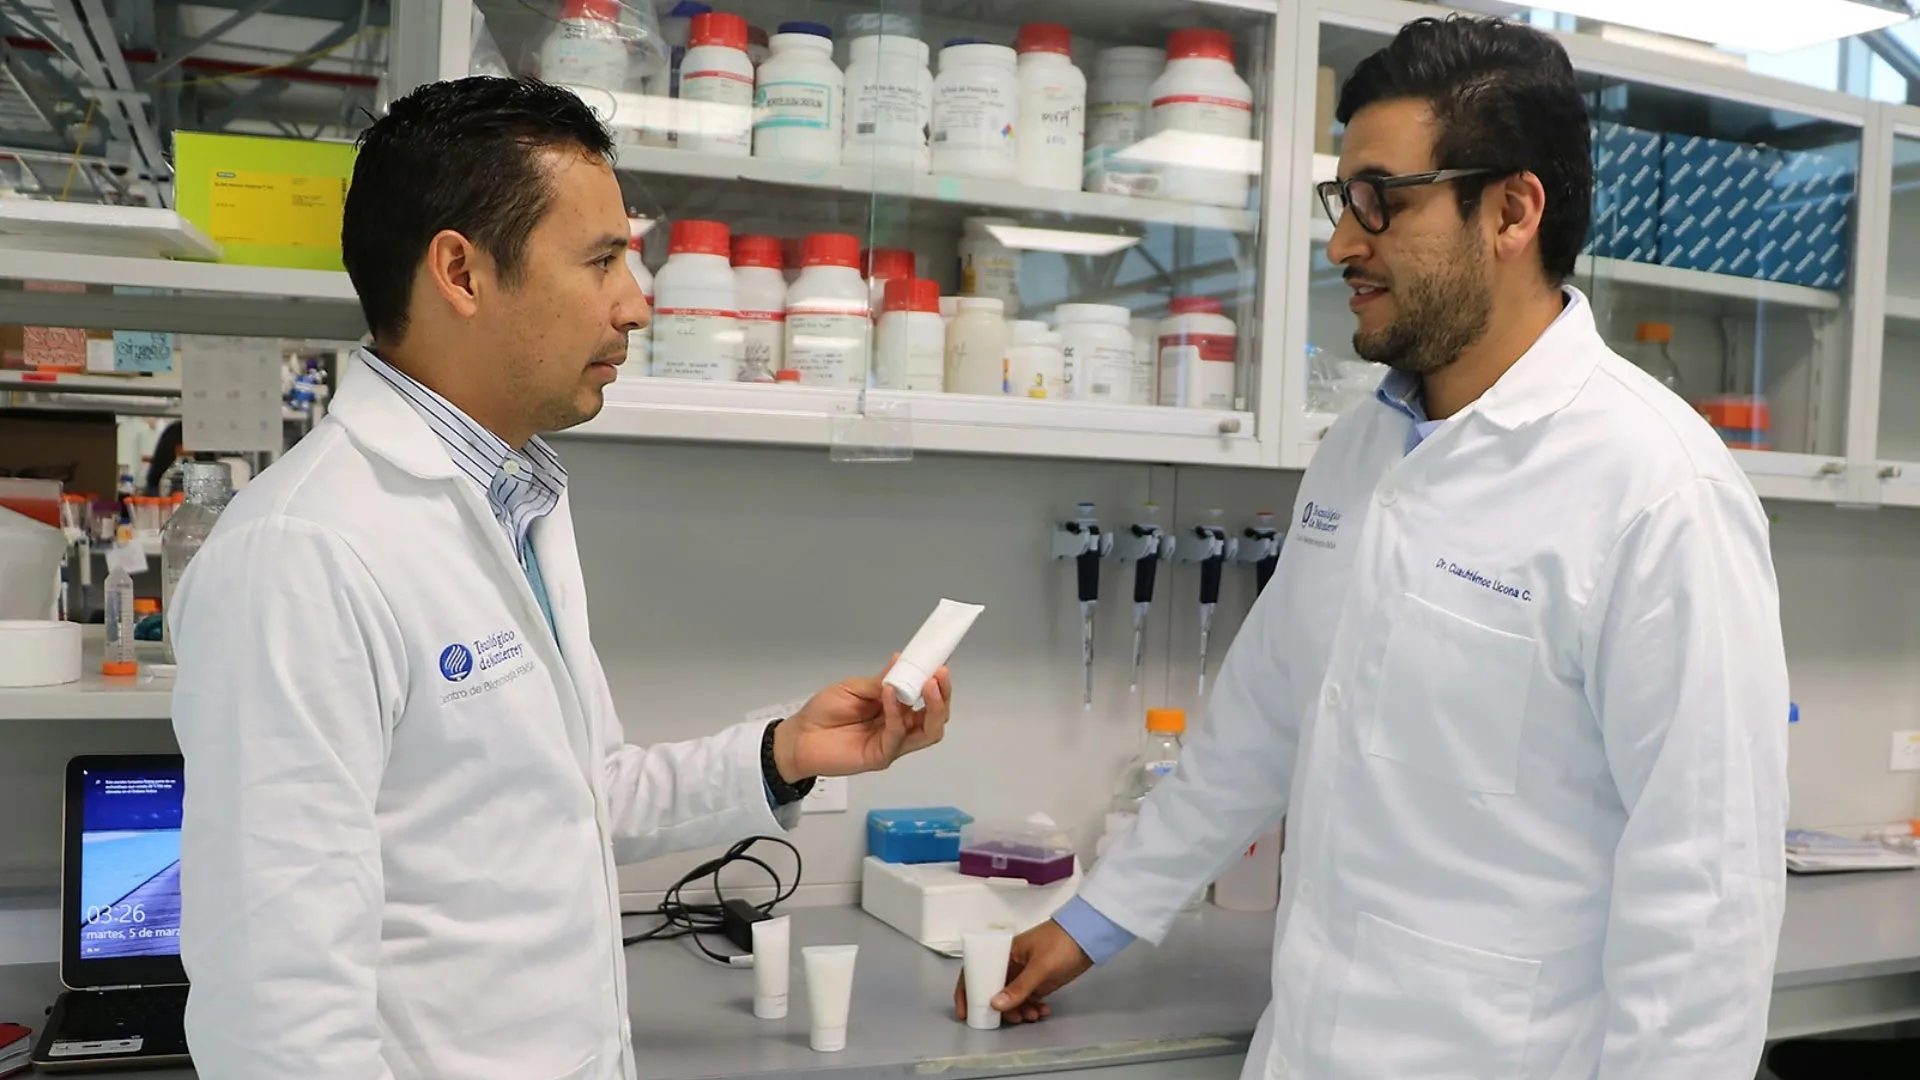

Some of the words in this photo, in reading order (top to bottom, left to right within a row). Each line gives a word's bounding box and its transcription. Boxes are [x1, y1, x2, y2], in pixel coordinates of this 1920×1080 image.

[1436, 558, 1447, 569] Dr.
[1448, 563, 1492, 588] Cuauhtémoc
[1492, 579, 1520, 598] Licona
[1521, 589, 1532, 602] C.
[479, 657, 491, 671] de
[469, 684, 482, 696] de
[87, 904, 146, 925] 03:26
[86, 930, 126, 941] martes,
[129, 928, 137, 938] 5
[139, 927, 153, 938] de
